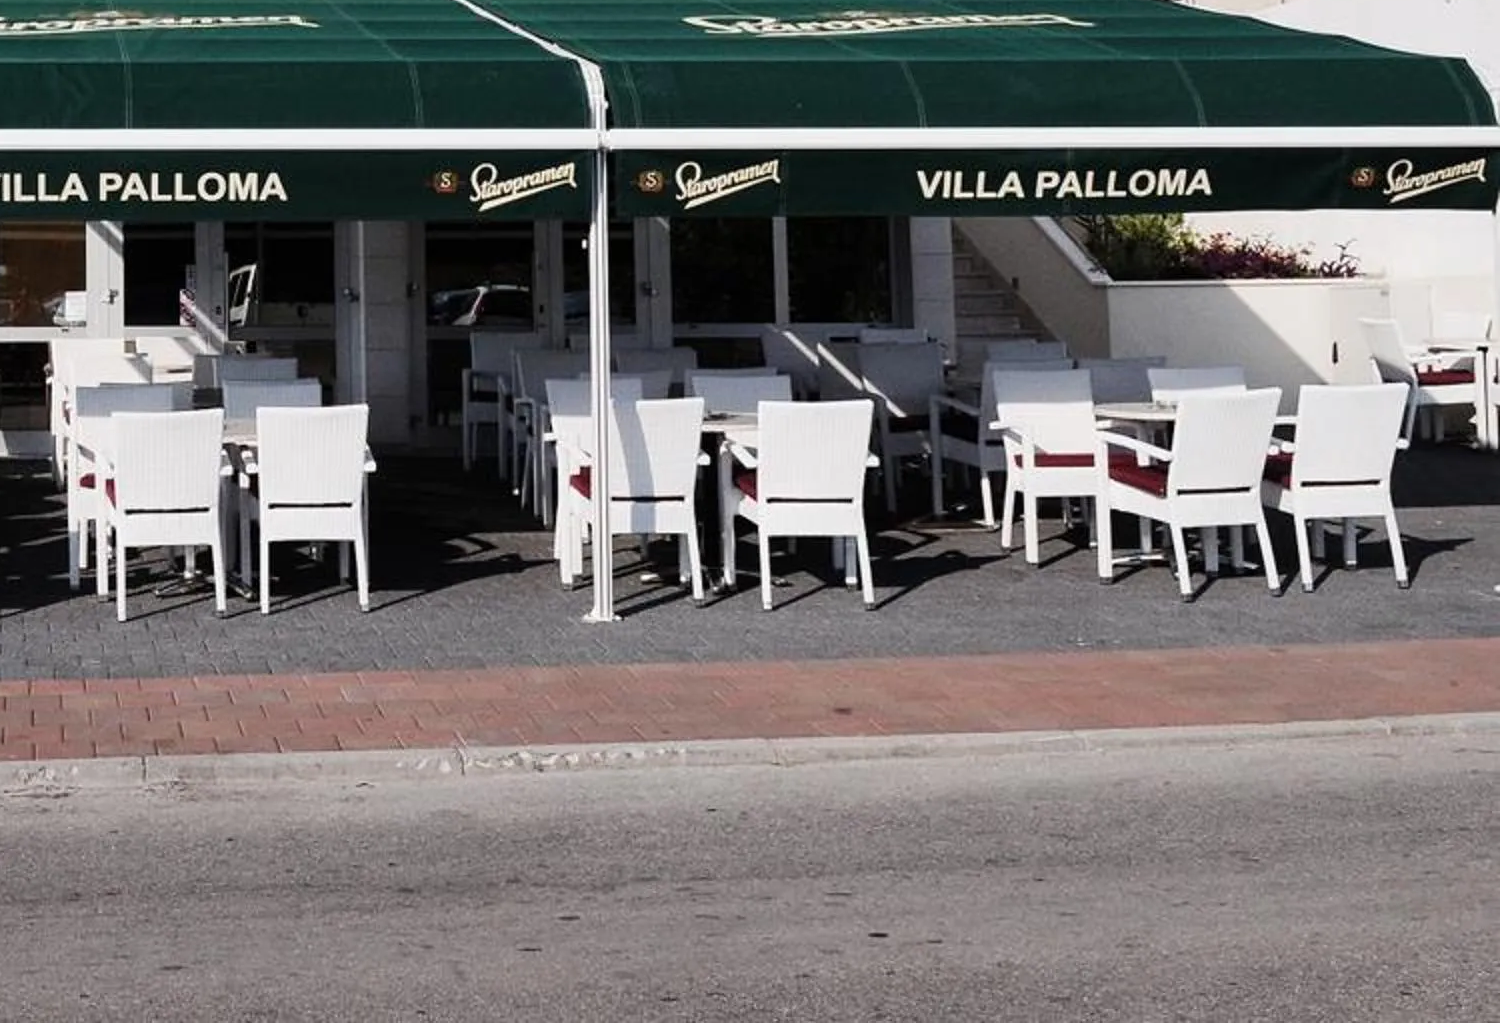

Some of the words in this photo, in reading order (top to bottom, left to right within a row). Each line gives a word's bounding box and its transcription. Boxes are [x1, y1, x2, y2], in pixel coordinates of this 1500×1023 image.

[99, 172, 288, 202] PALLOMA
[469, 162, 577, 212] Staropramen
[675, 159, 781, 210] Staropramen
[916, 170, 1025, 199] VILLA
[1035, 168, 1213, 198] PALLOMA
[1383, 158, 1487, 204] Staropramen
